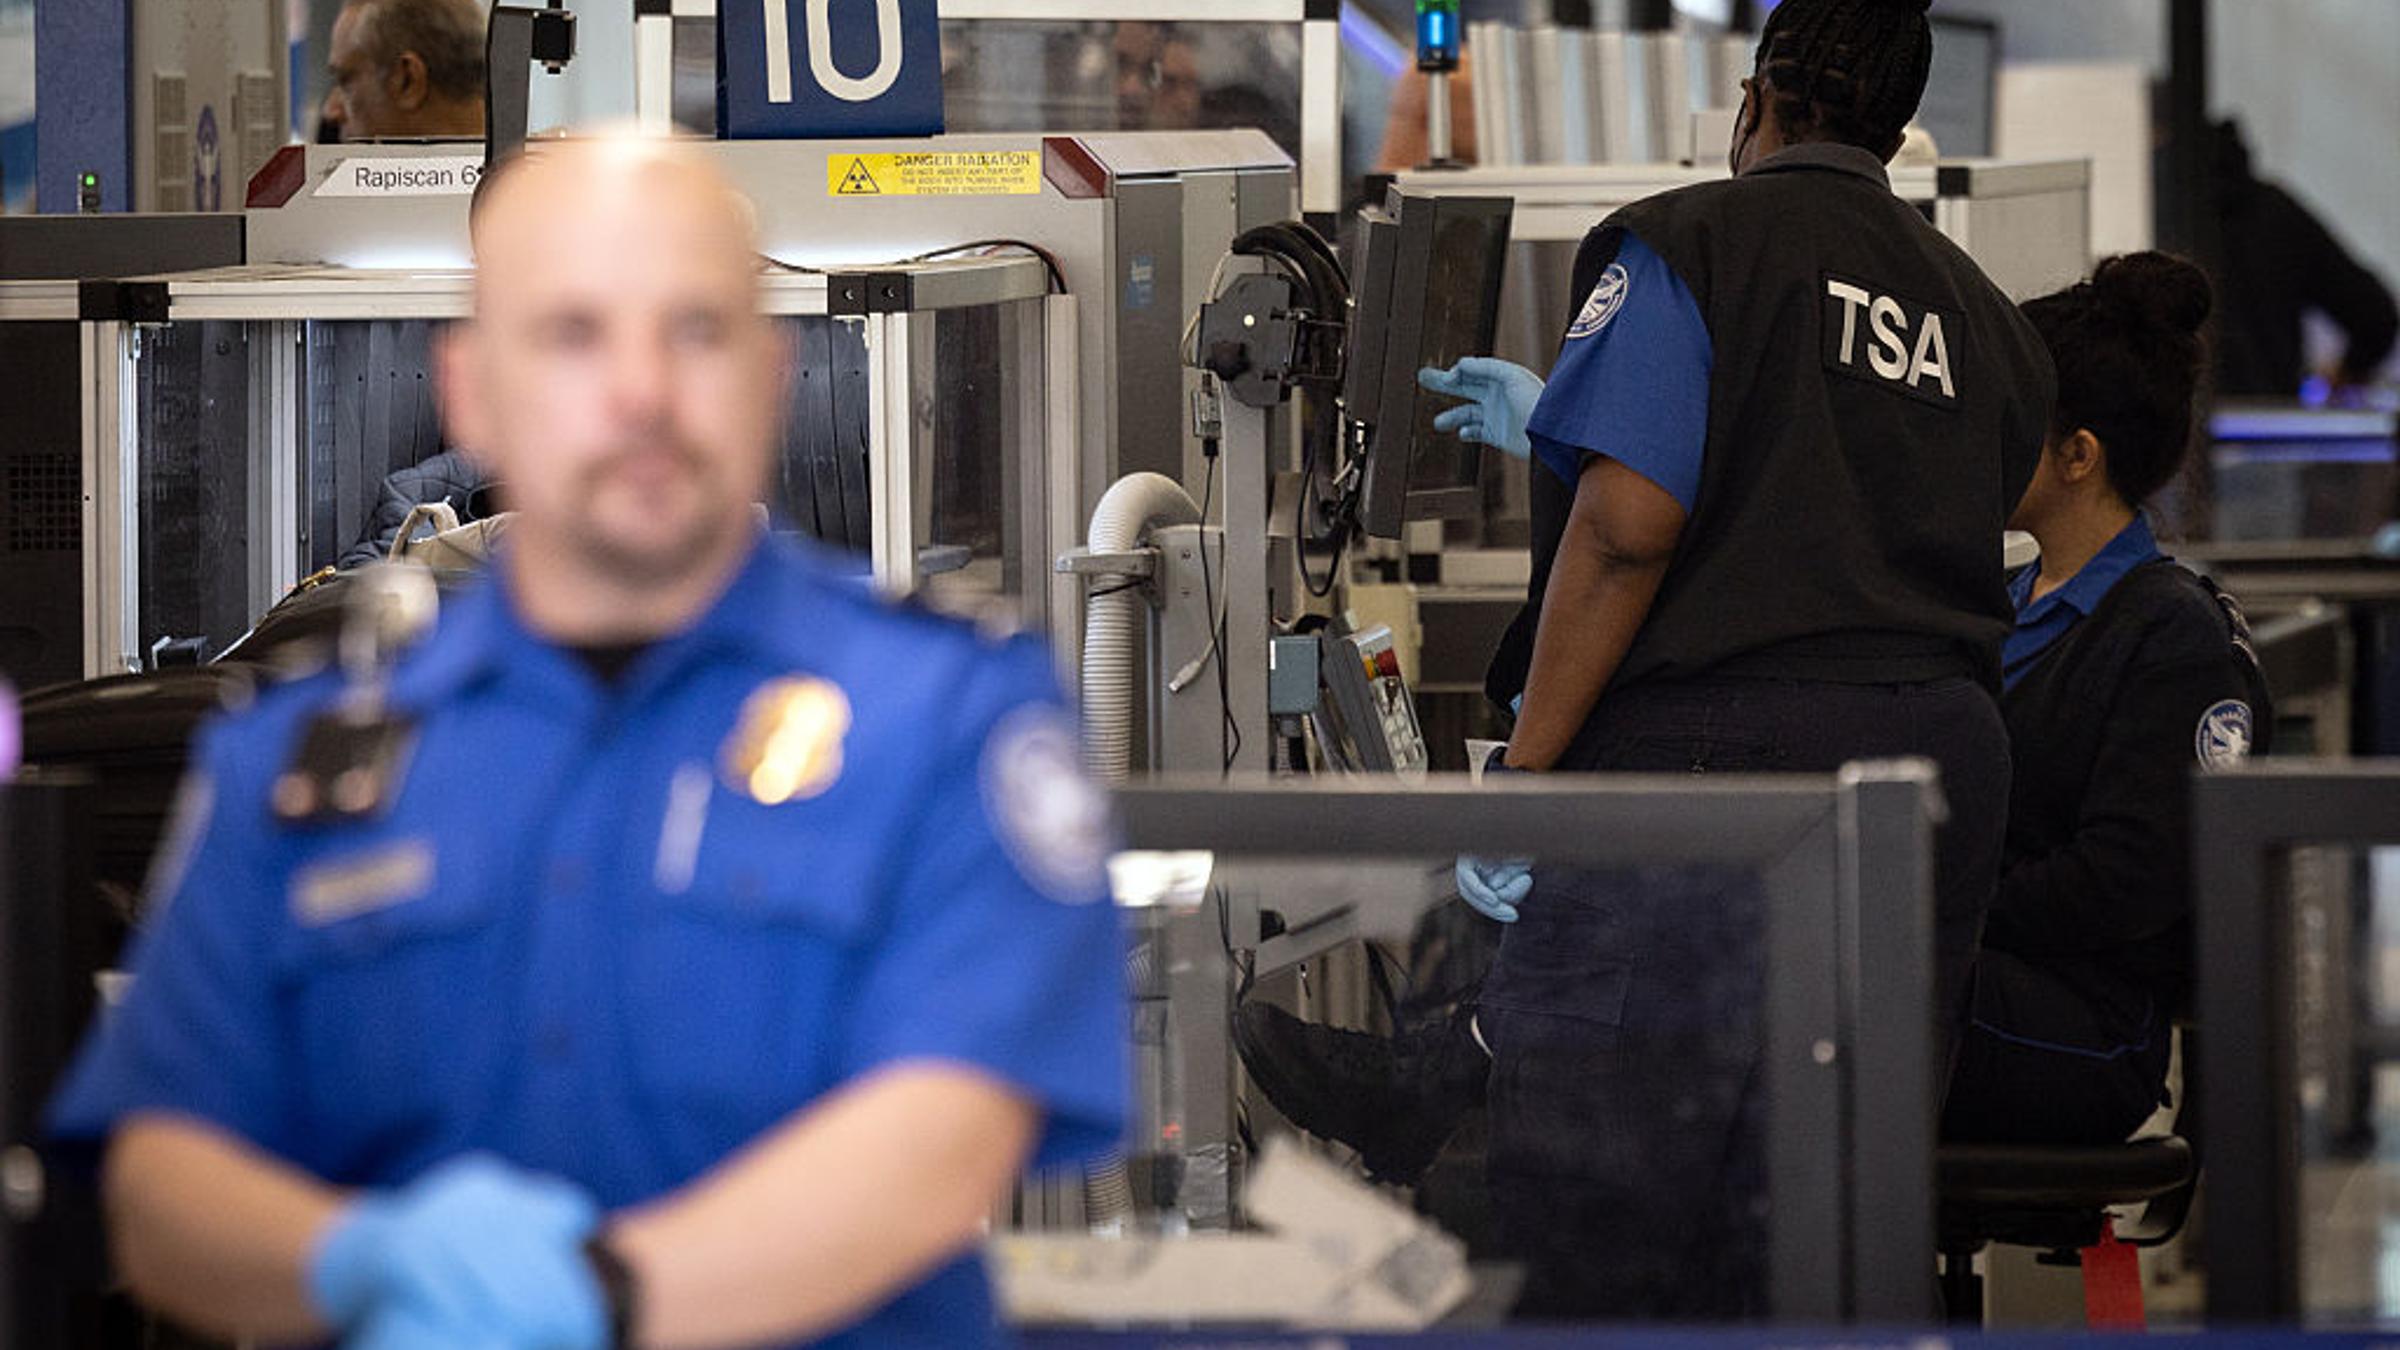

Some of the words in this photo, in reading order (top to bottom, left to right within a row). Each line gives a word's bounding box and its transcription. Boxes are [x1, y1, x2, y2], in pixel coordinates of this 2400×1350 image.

[764, 0, 903, 103] 10
[355, 166, 453, 190] Rapiscan
[461, 164, 482, 184] 6
[894, 154, 952, 166] DANGER
[1827, 279, 1956, 399] TSA
